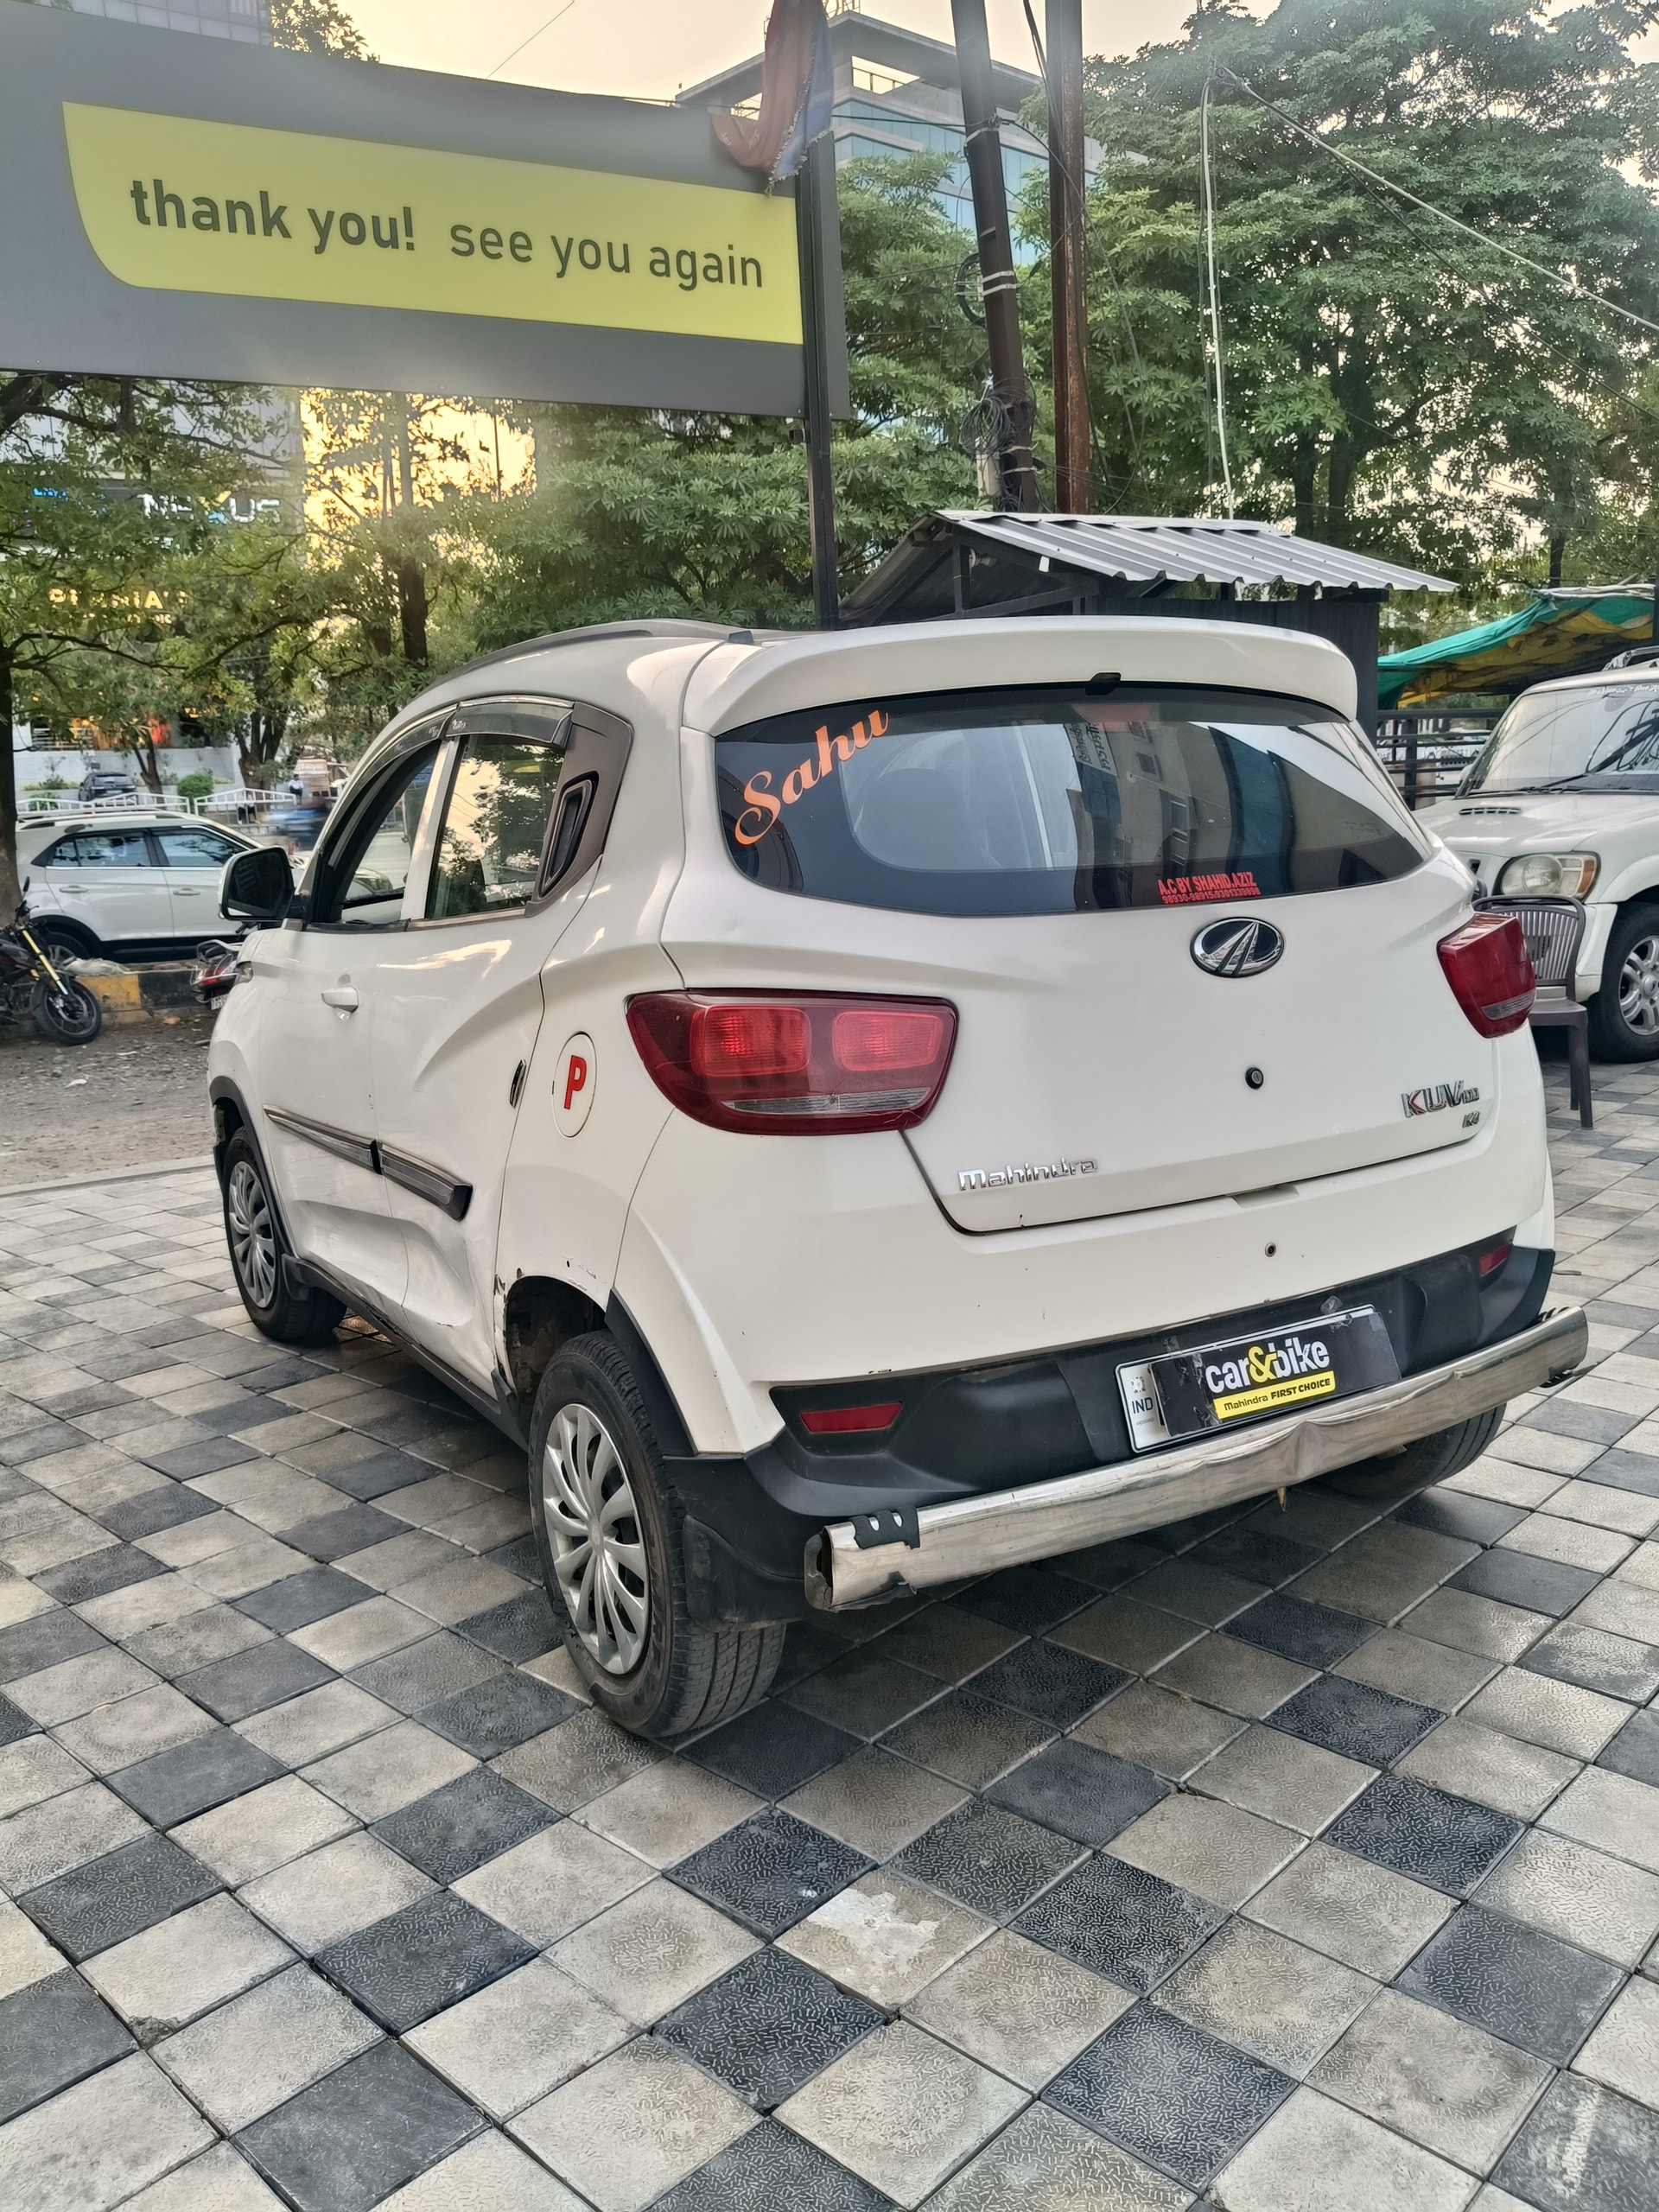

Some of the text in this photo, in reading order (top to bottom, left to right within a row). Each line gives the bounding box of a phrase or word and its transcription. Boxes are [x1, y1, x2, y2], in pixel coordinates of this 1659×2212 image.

[130, 179, 762, 291] thank you! see you again
[735, 709, 889, 845] Sahu
[1176, 876, 1192, 893] BY
[563, 1055, 588, 1109] P
[957, 1157, 1098, 1191] Mahindra
[1205, 1337, 1330, 1393] car&bike
[1132, 1396, 1154, 1414] IND
[1224, 1377, 1331, 1410] Mahindra FIRST CHOICE
